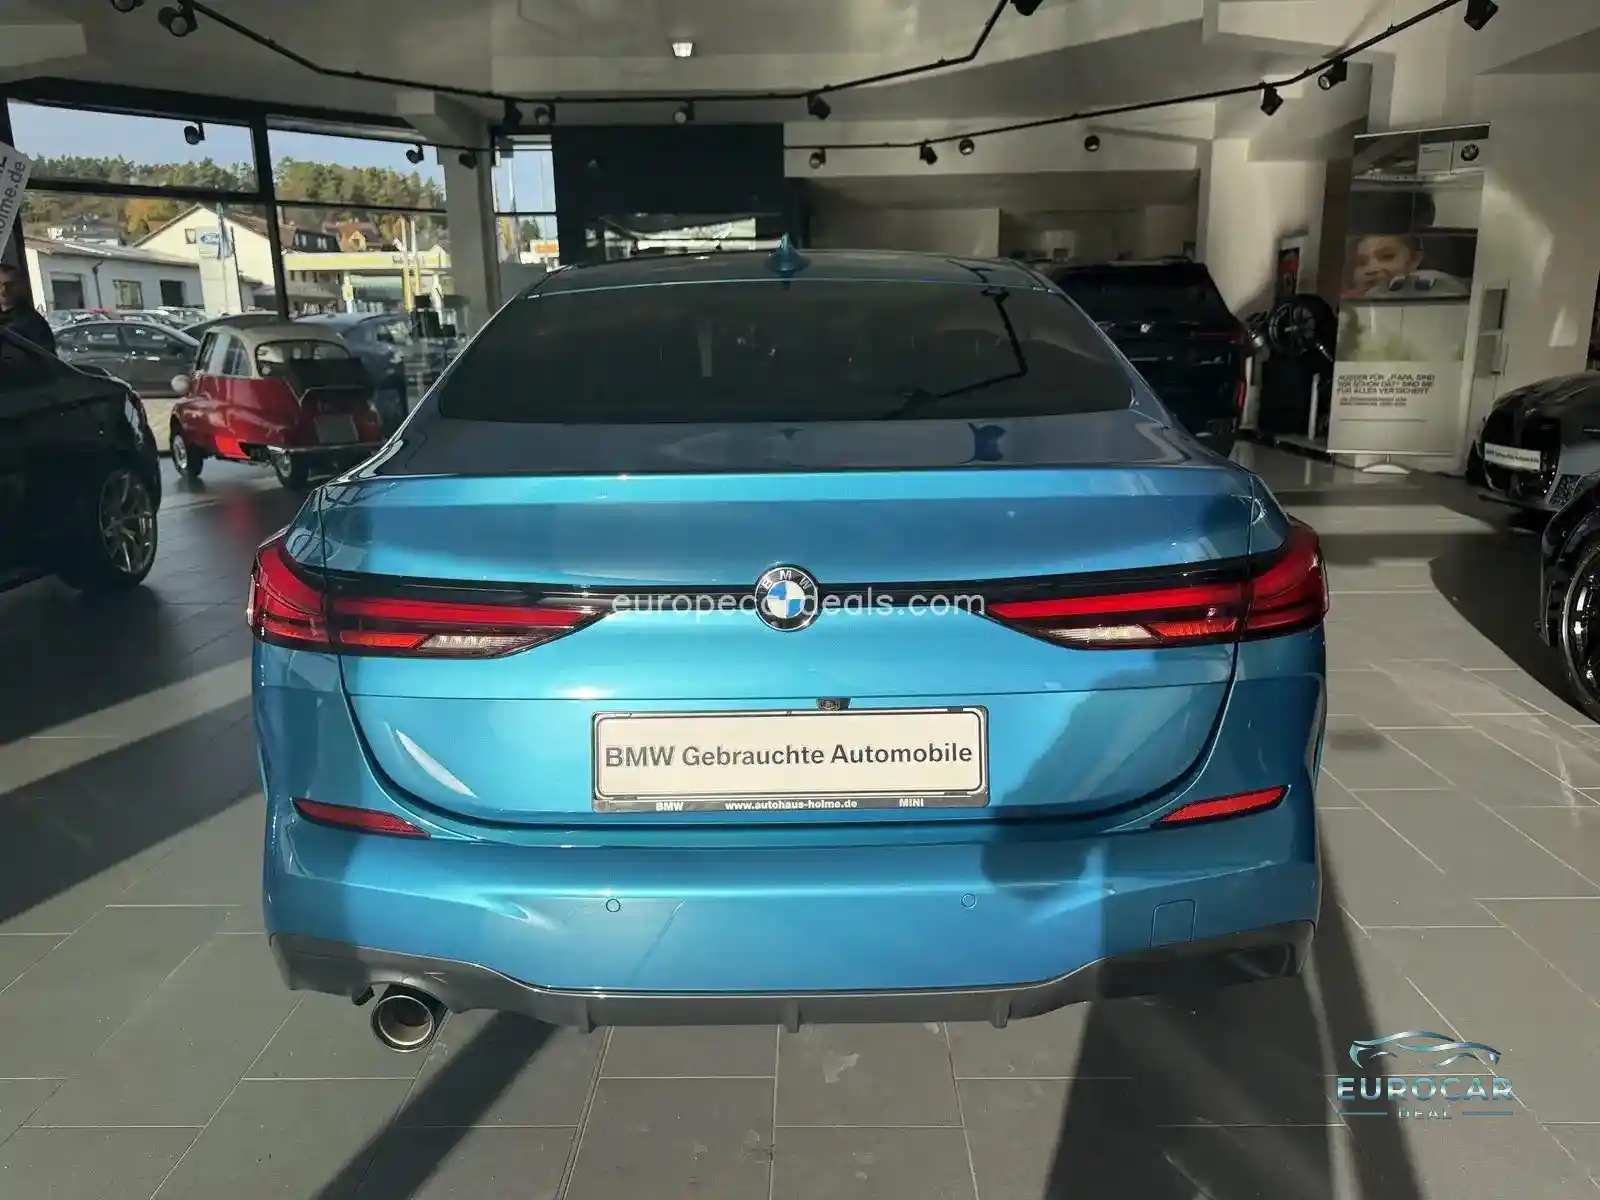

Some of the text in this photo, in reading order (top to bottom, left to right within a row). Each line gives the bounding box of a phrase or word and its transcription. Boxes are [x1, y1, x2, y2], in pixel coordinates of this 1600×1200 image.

[760, 570, 812, 590] BMW
[604, 742, 973, 768] BMW Gebrauchte Automobile
[655, 797, 924, 812] BMW www.autohaus-holme.de MINI
